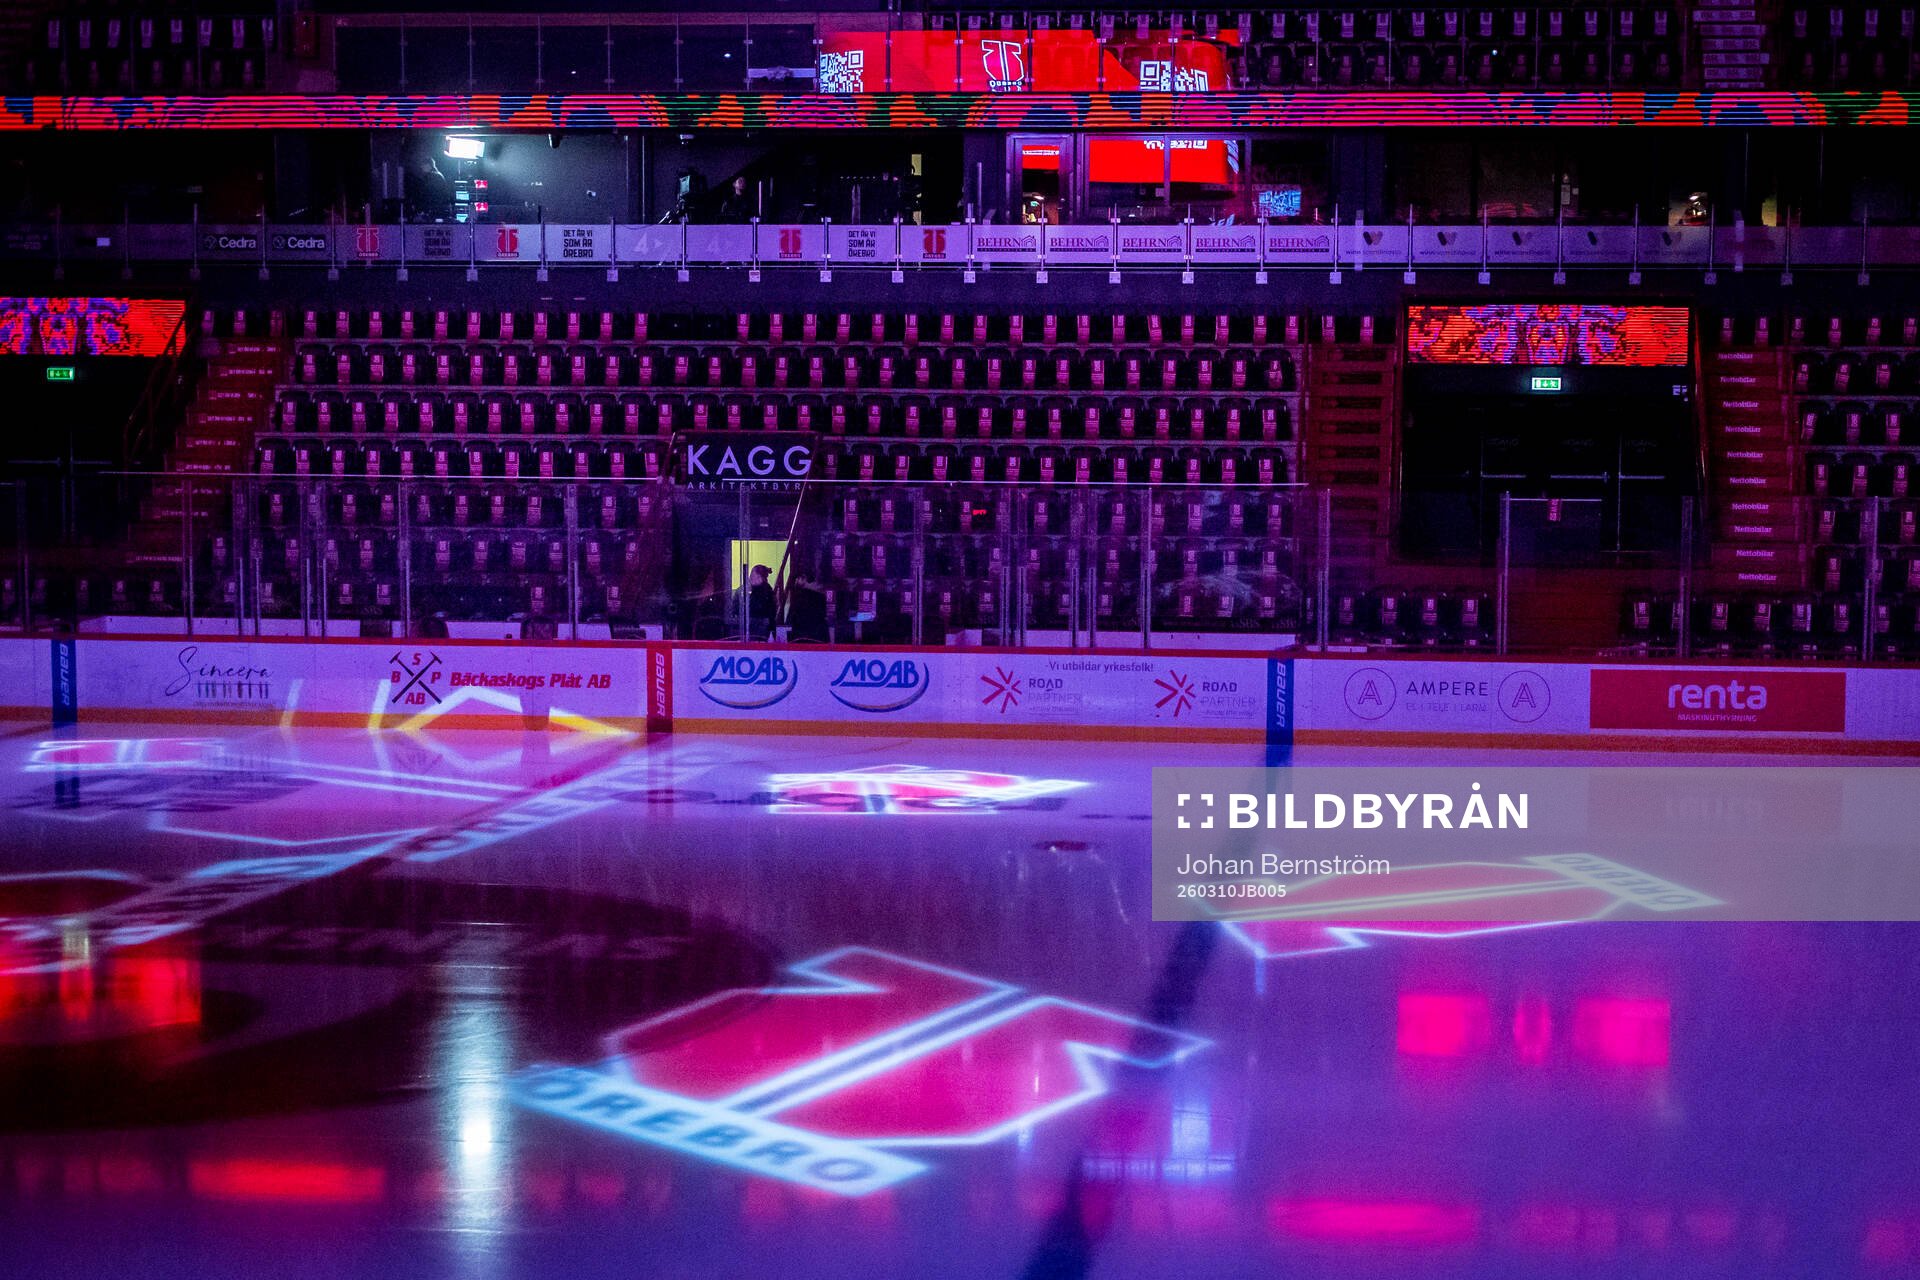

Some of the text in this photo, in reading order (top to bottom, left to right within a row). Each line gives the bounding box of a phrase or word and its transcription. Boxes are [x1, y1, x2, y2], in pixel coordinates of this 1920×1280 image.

[563, 229, 575, 238] DET
[586, 229, 593, 238] VI
[848, 230, 859, 238] DET
[869, 230, 876, 238] VI
[218, 238, 256, 249] Cedra
[287, 238, 325, 249] Cedra
[563, 239, 580, 248] SOM
[848, 239, 864, 248] SOM
[978, 237, 1021, 248] BEHRN
[1051, 237, 1094, 248] BEHRN
[1123, 237, 1167, 248] BEHRN
[1196, 237, 1240, 248] BEHRN
[1270, 237, 1314, 248] BEHRN
[1726, 450, 1763, 458] Nettobilar
[687, 444, 812, 476] KAGG
[1736, 549, 1775, 557] Nettobilar
[1738, 573, 1777, 581] Nettobilar
[412, 652, 421, 666] S
[164, 645, 275, 697] Sincera
[701, 655, 788, 685] MOAB
[1062, 660, 1101, 672] utbildar
[1103, 662, 1154, 674] yrkesfolk!
[391, 670, 442, 684] B P
[831, 659, 919, 689] MOAB
[450, 671, 611, 690] Bäckaskogs Plåt AB
[1028, 678, 1064, 690] ROAD
[1202, 681, 1238, 693] ROAD
[1405, 680, 1489, 697] AMPERE
[405, 691, 426, 705] AB
[1667, 679, 1767, 710] renta
[1677, 714, 1758, 723] MASKINUTHYRNING
